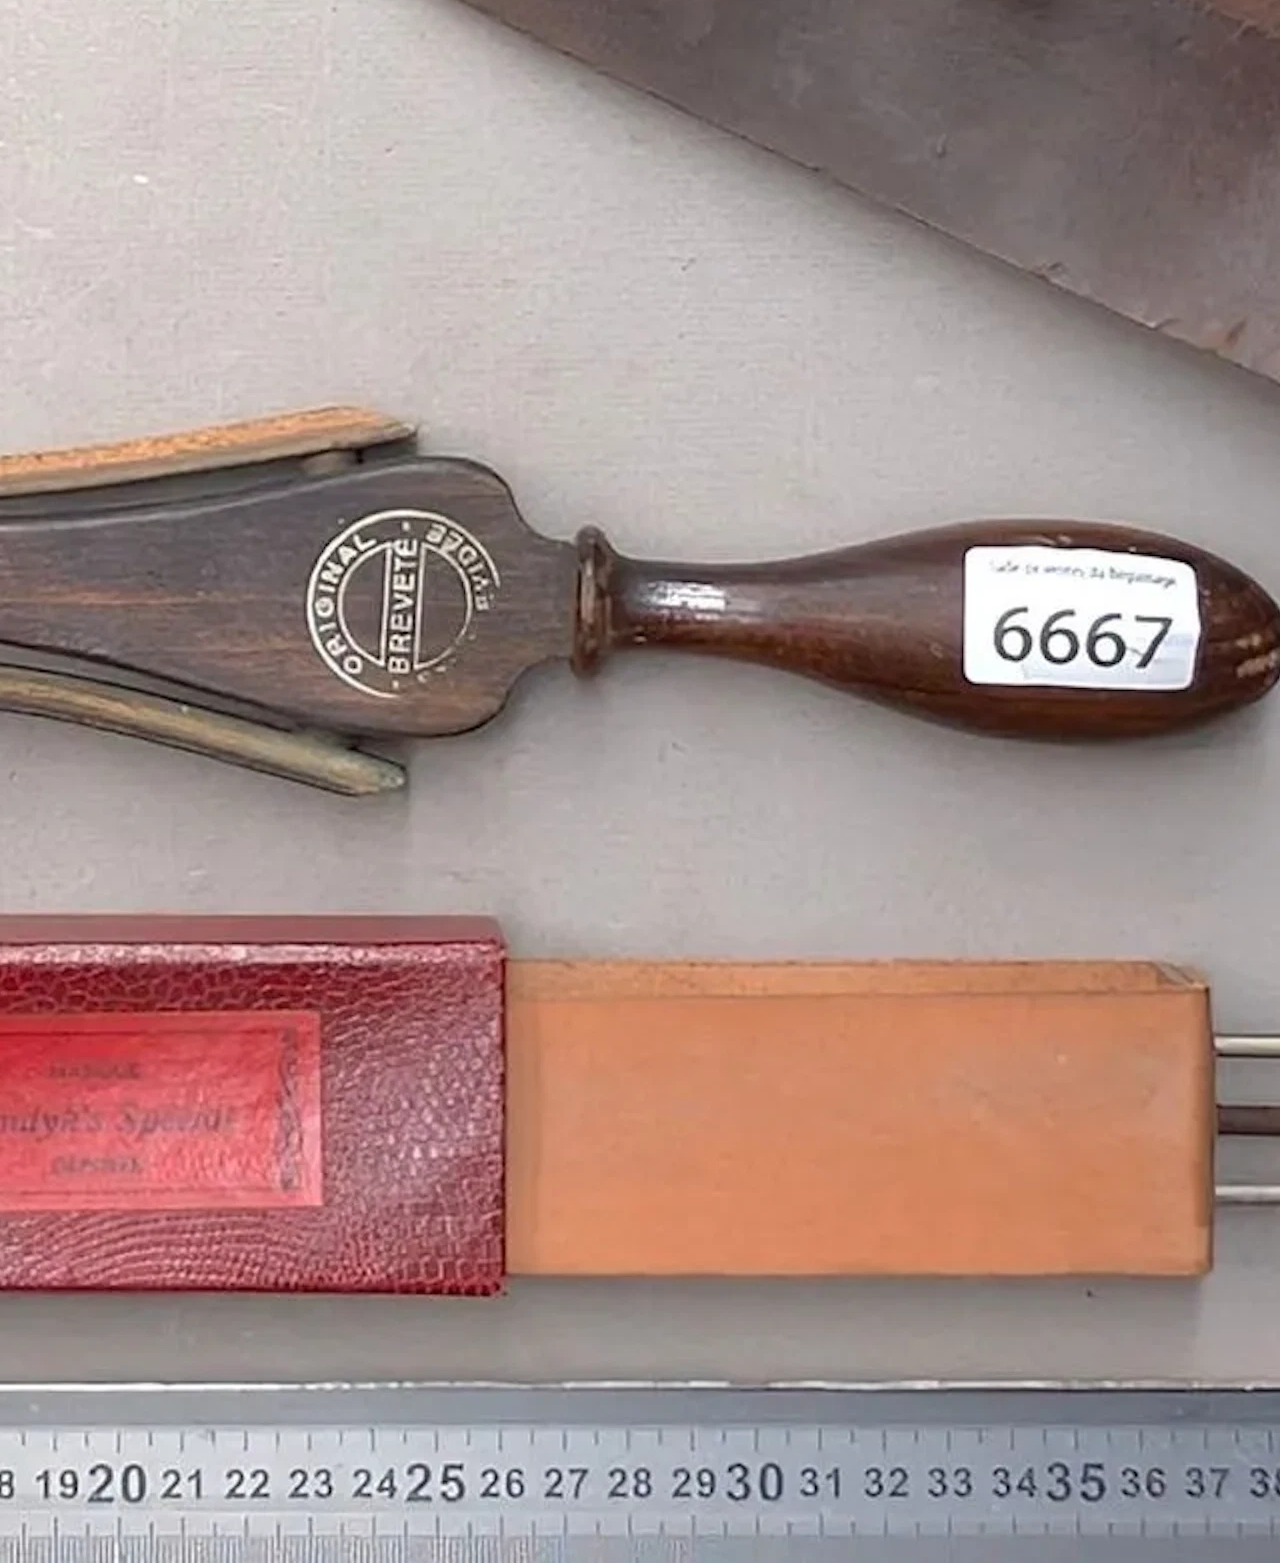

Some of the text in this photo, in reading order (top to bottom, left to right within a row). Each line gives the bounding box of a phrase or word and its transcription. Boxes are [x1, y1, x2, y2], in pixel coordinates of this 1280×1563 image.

[314, 533, 377, 675] ORIGINAL
[993, 605, 1174, 670] 6667
[35, 1469, 78, 1498] 19
[87, 1463, 146, 1503] 20
[161, 1468, 201, 1499] 21
[225, 1468, 270, 1499] 22
[288, 1468, 333, 1498] 23
[352, 1467, 397, 1499] 24
[406, 1463, 465, 1502] 25
[480, 1468, 524, 1498] 26
[544, 1467, 588, 1499] 27
[608, 1467, 652, 1498] 28
[672, 1467, 715, 1498] 29
[726, 1462, 783, 1501] 30
[800, 1467, 839, 1498] 31
[864, 1467, 908, 1497] 32
[927, 1467, 972, 1498] 33
[992, 1467, 1037, 1498] 34
[1046, 1462, 1106, 1502] 35
[1121, 1467, 1165, 1498] 36
[1185, 1467, 1229, 1498] 37
